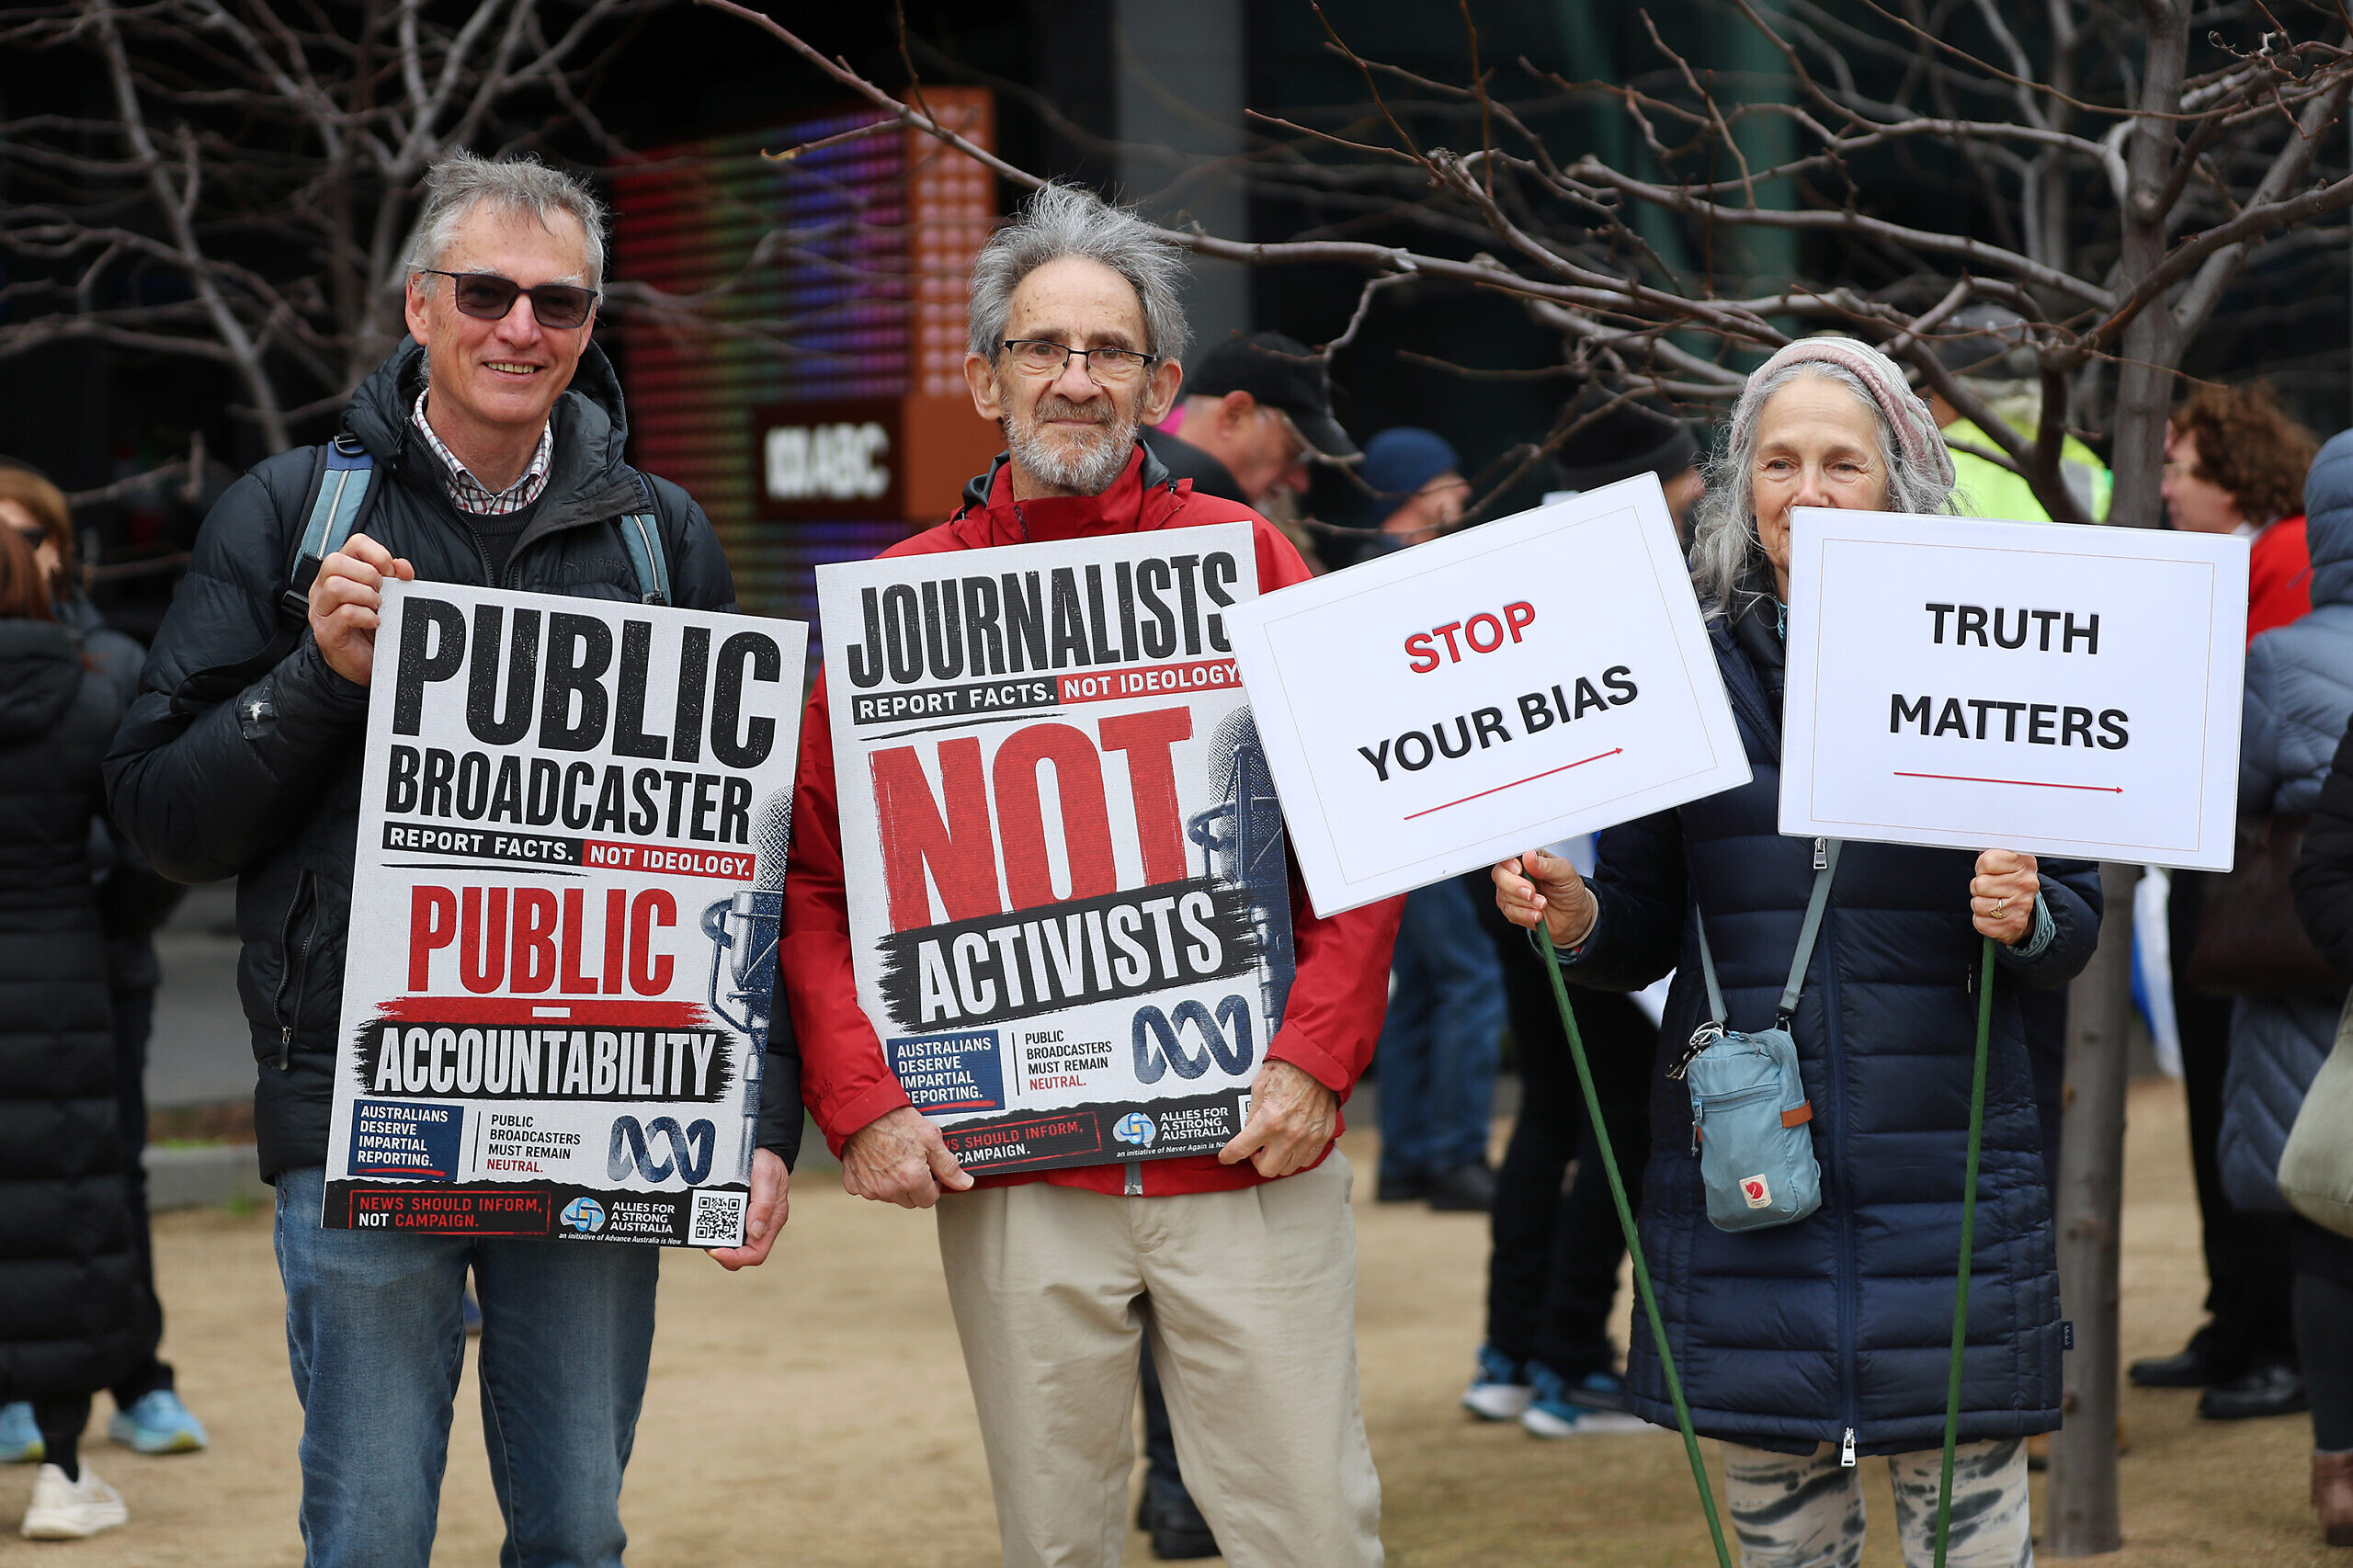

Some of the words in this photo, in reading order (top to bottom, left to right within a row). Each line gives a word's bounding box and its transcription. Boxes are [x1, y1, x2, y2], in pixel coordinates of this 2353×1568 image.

[847, 551, 1237, 688] JOURNALISTS
[1404, 600, 1538, 675] STOP
[1925, 602, 2099, 656] TRUTH
[392, 596, 781, 769] PUBLIC
[859, 692, 958, 719] REPORT
[970, 683, 1054, 709] FACTS.
[1064, 676, 1109, 699] NOT
[1358, 707, 1512, 782] YOUR
[1517, 665, 1639, 735] BIAS
[1890, 694, 2129, 751] MATTERS
[385, 744, 754, 845] BROADCASTER
[869, 706, 1193, 934] NOT
[390, 828, 483, 853] REPORT
[494, 836, 574, 862] FACTS.
[590, 845, 636, 868] NOT
[642, 849, 750, 877] IDEOLOGY.
[407, 885, 677, 996] PUBLIC
[918, 891, 1223, 1024] ACTIVISTS
[1025, 1029, 1064, 1045] PUBLIC
[896, 1037, 992, 1058] AUSTRALIANS
[1026, 1040, 1112, 1060] BROADCASTERS
[374, 1027, 716, 1096] ACCOUNTABILITY
[898, 1056, 961, 1074] DESERVE
[1028, 1061, 1061, 1075] MUST
[1063, 1056, 1108, 1073] REMAIN
[900, 1071, 974, 1089] IMPARTIAL
[1029, 1074, 1086, 1091] NEUTRAL.
[360, 1105, 449, 1123] AUSTRALIANS
[491, 1114, 534, 1128] PUBLIC
[1160, 1108, 1201, 1122] ALLIES
[1203, 1107, 1229, 1118] FOR
[359, 1120, 417, 1136] DESERVE
[1160, 1122, 1171, 1131] A
[1172, 1117, 1222, 1131] STRONG
[490, 1129, 581, 1145] BROADCASTERS
[965, 1129, 1020, 1149] SHOULD
[1025, 1120, 1084, 1140] INFORM,
[1162, 1125, 1231, 1142] AUSTRALIA
[358, 1135, 427, 1152] IMPARTIAL
[488, 1143, 523, 1157] MUST
[525, 1146, 571, 1160] REMAIN
[1126, 1147, 1156, 1156] initiative
[1156, 1146, 1165, 1154] of
[1165, 1144, 1188, 1153] Never
[1188, 1142, 1207, 1152] Again
[357, 1150, 433, 1167] REPORTING.
[956, 1143, 1030, 1165] CAMPAIGN.
[486, 1158, 543, 1173] NEUTRAL.
[359, 1197, 404, 1210] NEWS
[411, 1198, 472, 1211] SHOULD
[479, 1199, 542, 1213] INFORM,
[611, 1201, 650, 1213] ALLIES
[652, 1203, 676, 1214] FOR
[358, 1213, 390, 1227] NOT
[395, 1214, 479, 1228] CAMPAIGN.
[610, 1211, 620, 1221] A
[621, 1212, 668, 1223] STRONG
[609, 1221, 673, 1233] AUSTRALIA
[568, 1232, 596, 1241] initiative
[597, 1233, 605, 1242] of
[631, 1236, 660, 1244] Australia
